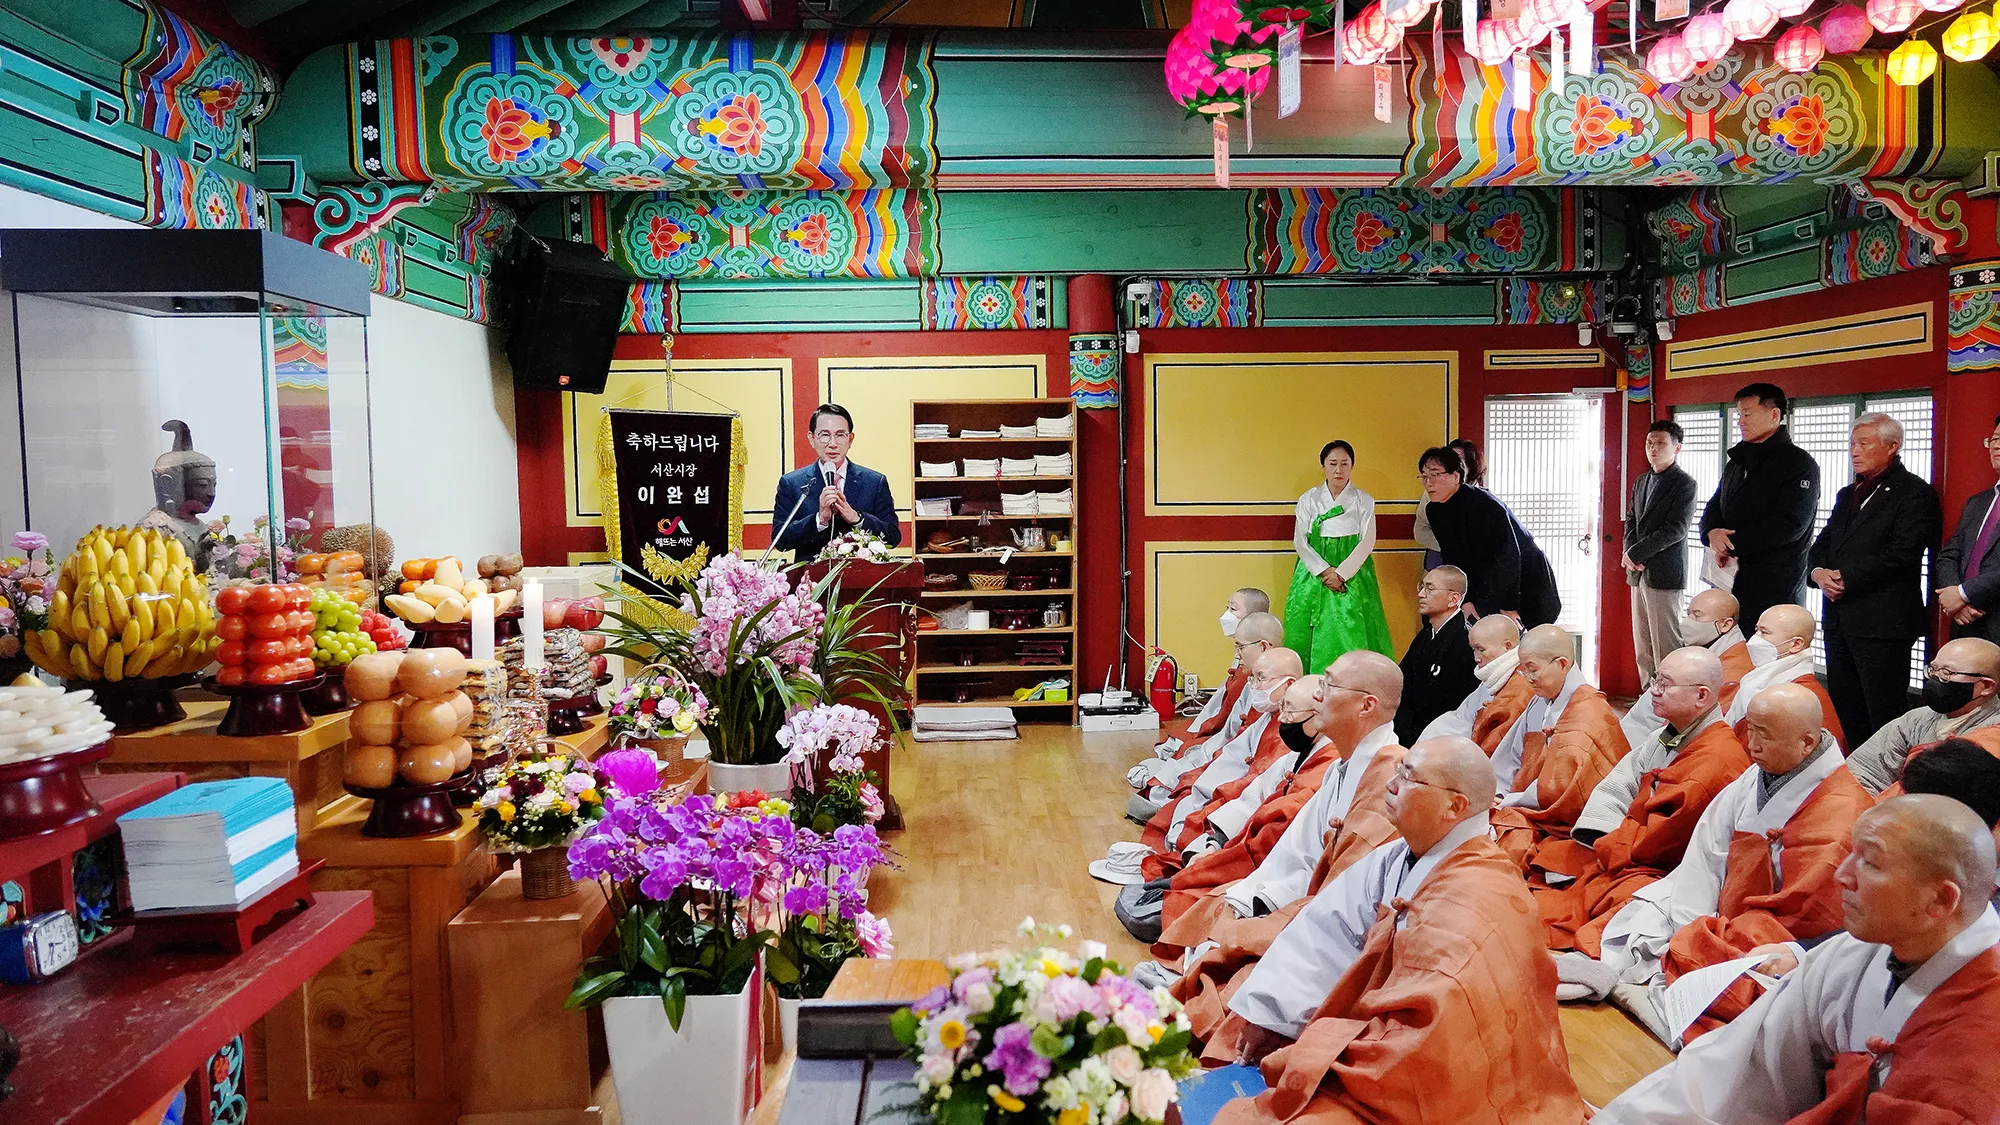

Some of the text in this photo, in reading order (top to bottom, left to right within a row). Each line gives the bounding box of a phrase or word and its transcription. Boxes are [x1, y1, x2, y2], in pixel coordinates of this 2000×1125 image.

[626, 432, 719, 453] 축하드립니다
[650, 463, 697, 477] 서산시장
[678, 536, 693, 547] 서산
